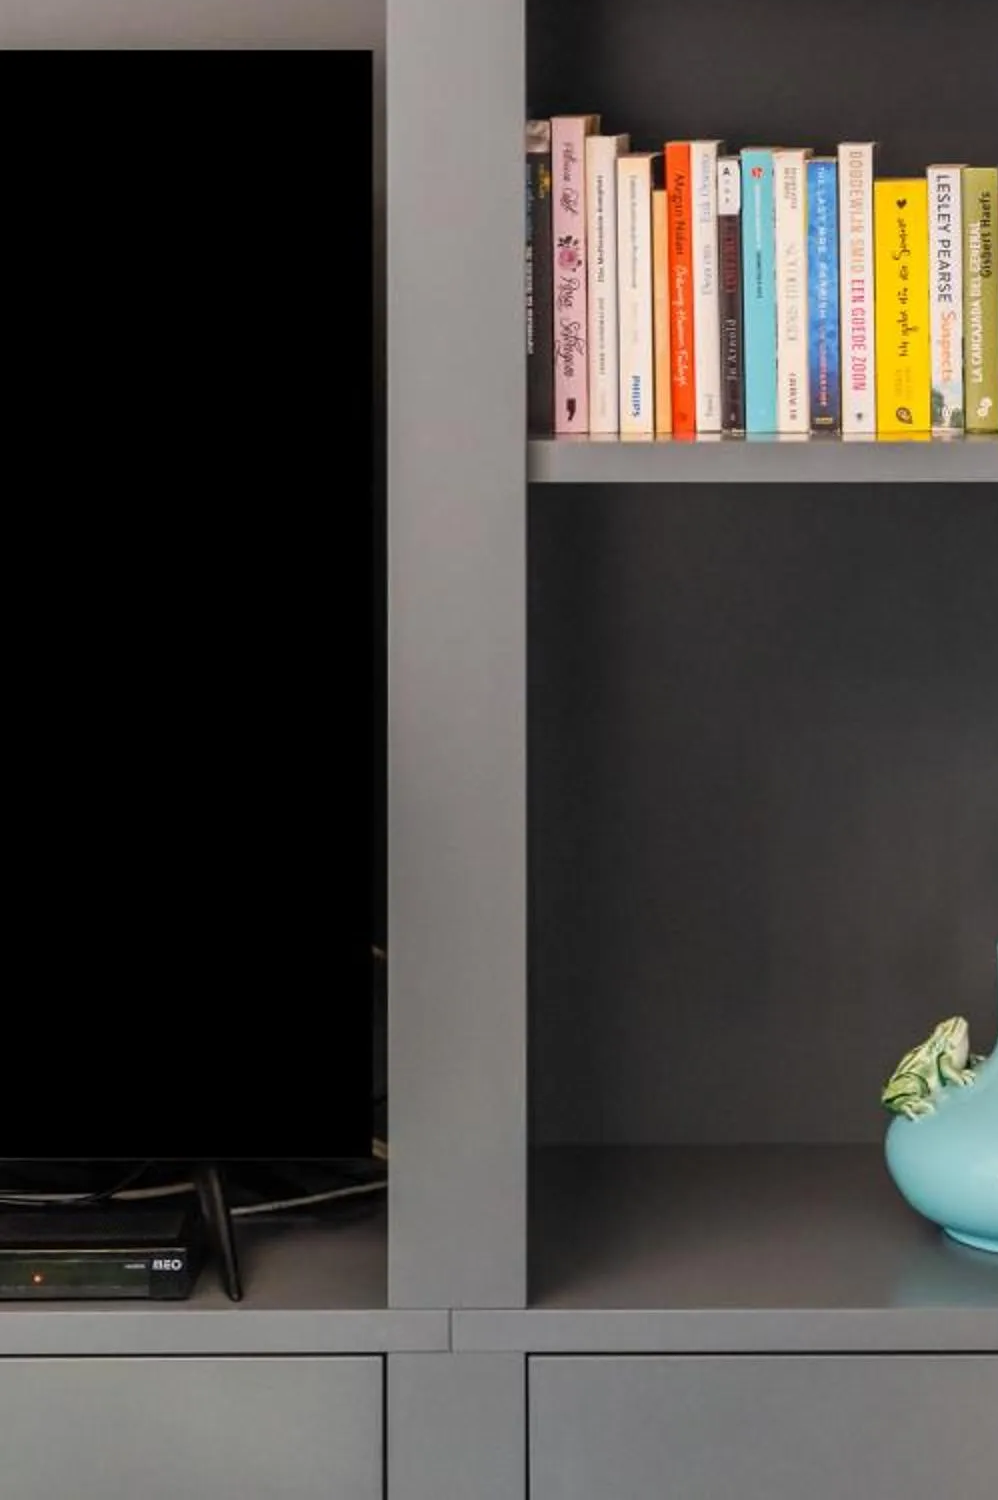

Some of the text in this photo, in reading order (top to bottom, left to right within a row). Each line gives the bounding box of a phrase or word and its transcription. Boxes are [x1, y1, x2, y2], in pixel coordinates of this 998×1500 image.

[672, 171, 686, 217] Megan
[816, 190, 826, 224] LAST
[936, 175, 953, 304] LESLEY PEARSE
[979, 192, 992, 278] Gisbert Haefs
[850, 278, 867, 392] EEN GOEDE ZOON
[939, 311, 957, 382] Suspects
[630, 375, 641, 418] PHILIPS
[972, 368, 983, 382] LA
